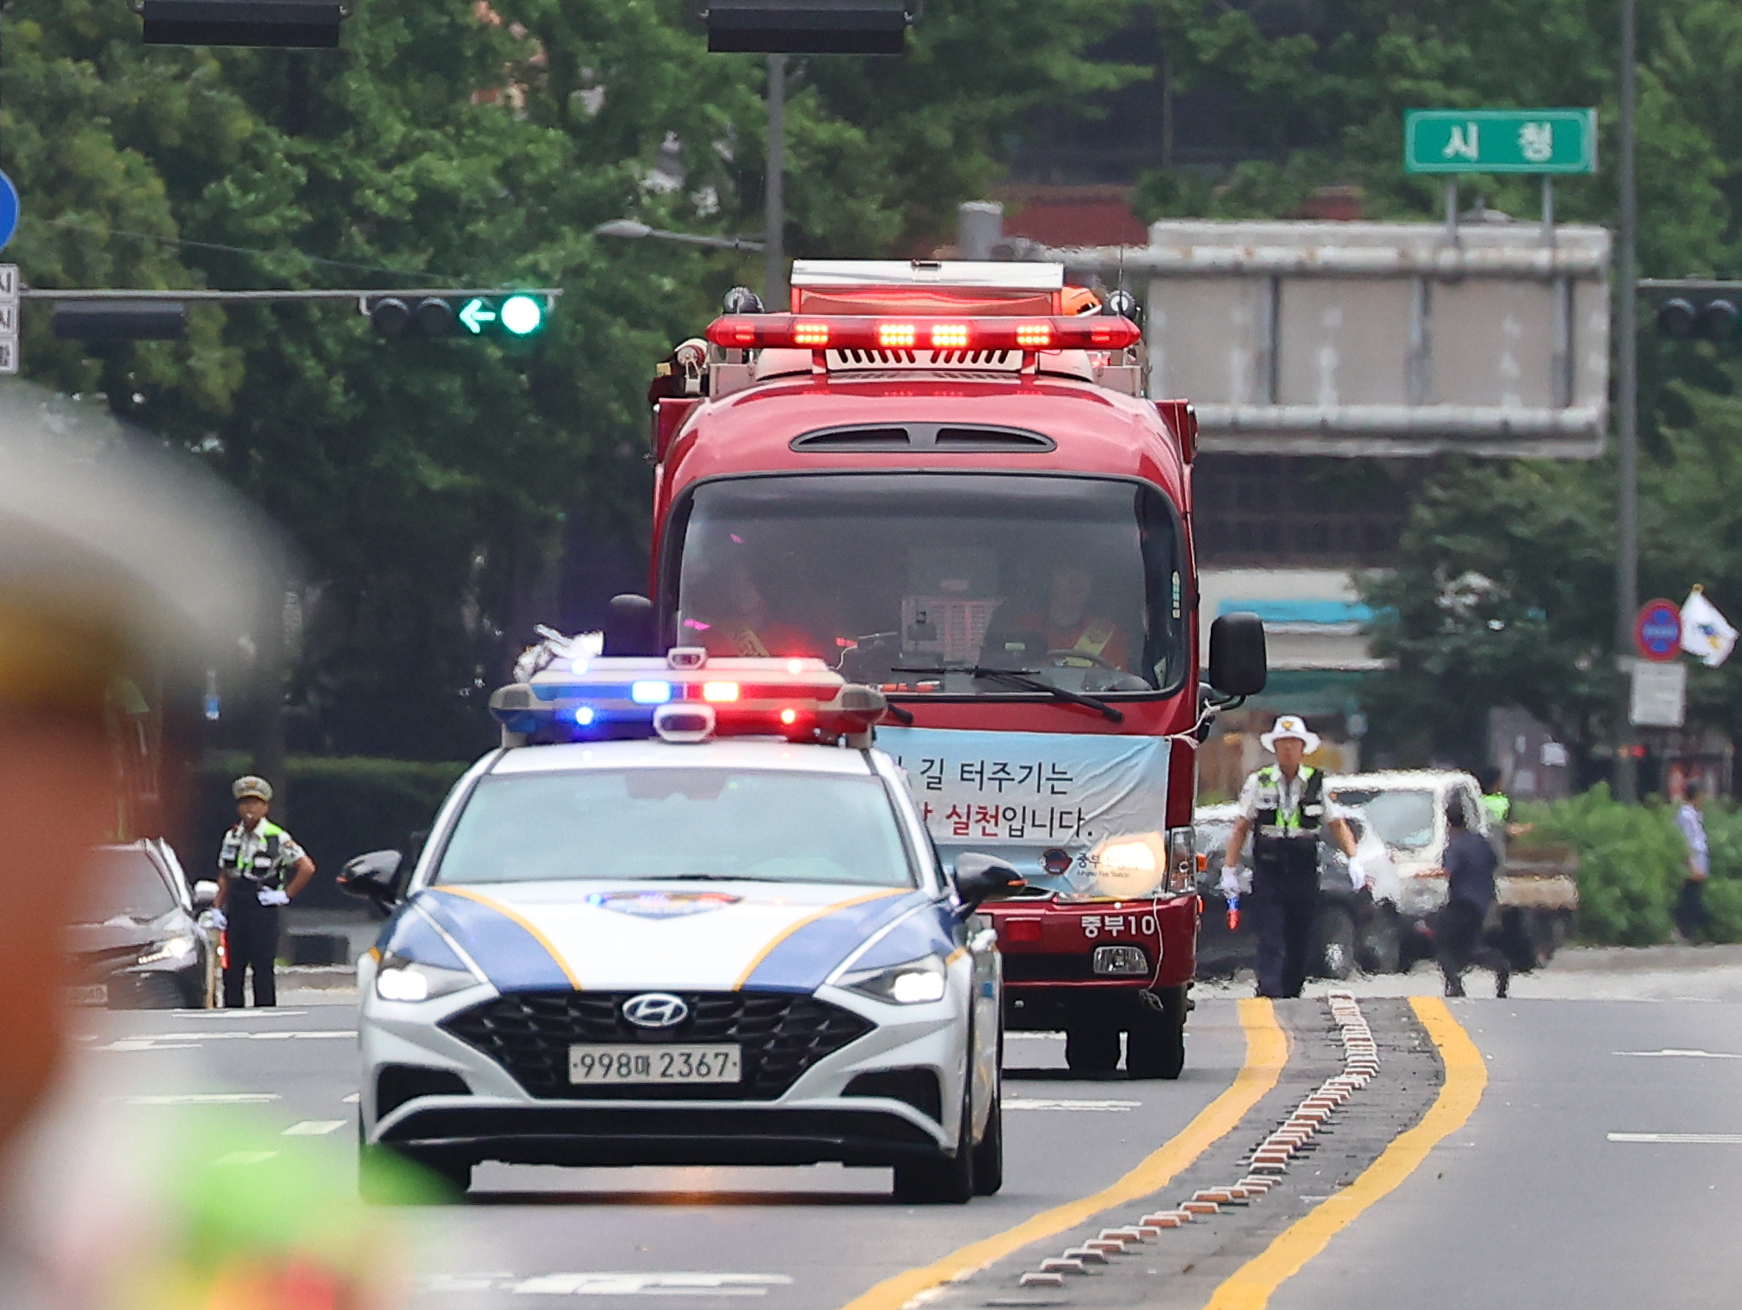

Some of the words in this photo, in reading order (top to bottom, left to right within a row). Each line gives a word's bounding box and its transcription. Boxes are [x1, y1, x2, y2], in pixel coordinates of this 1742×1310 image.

[919, 757, 945, 790] 길
[960, 760, 1074, 795] 터주기는
[945, 803, 1093, 838] 실천입니다.
[1081, 915, 1155, 938] 중부10
[659, 1052, 730, 1077] 2367
